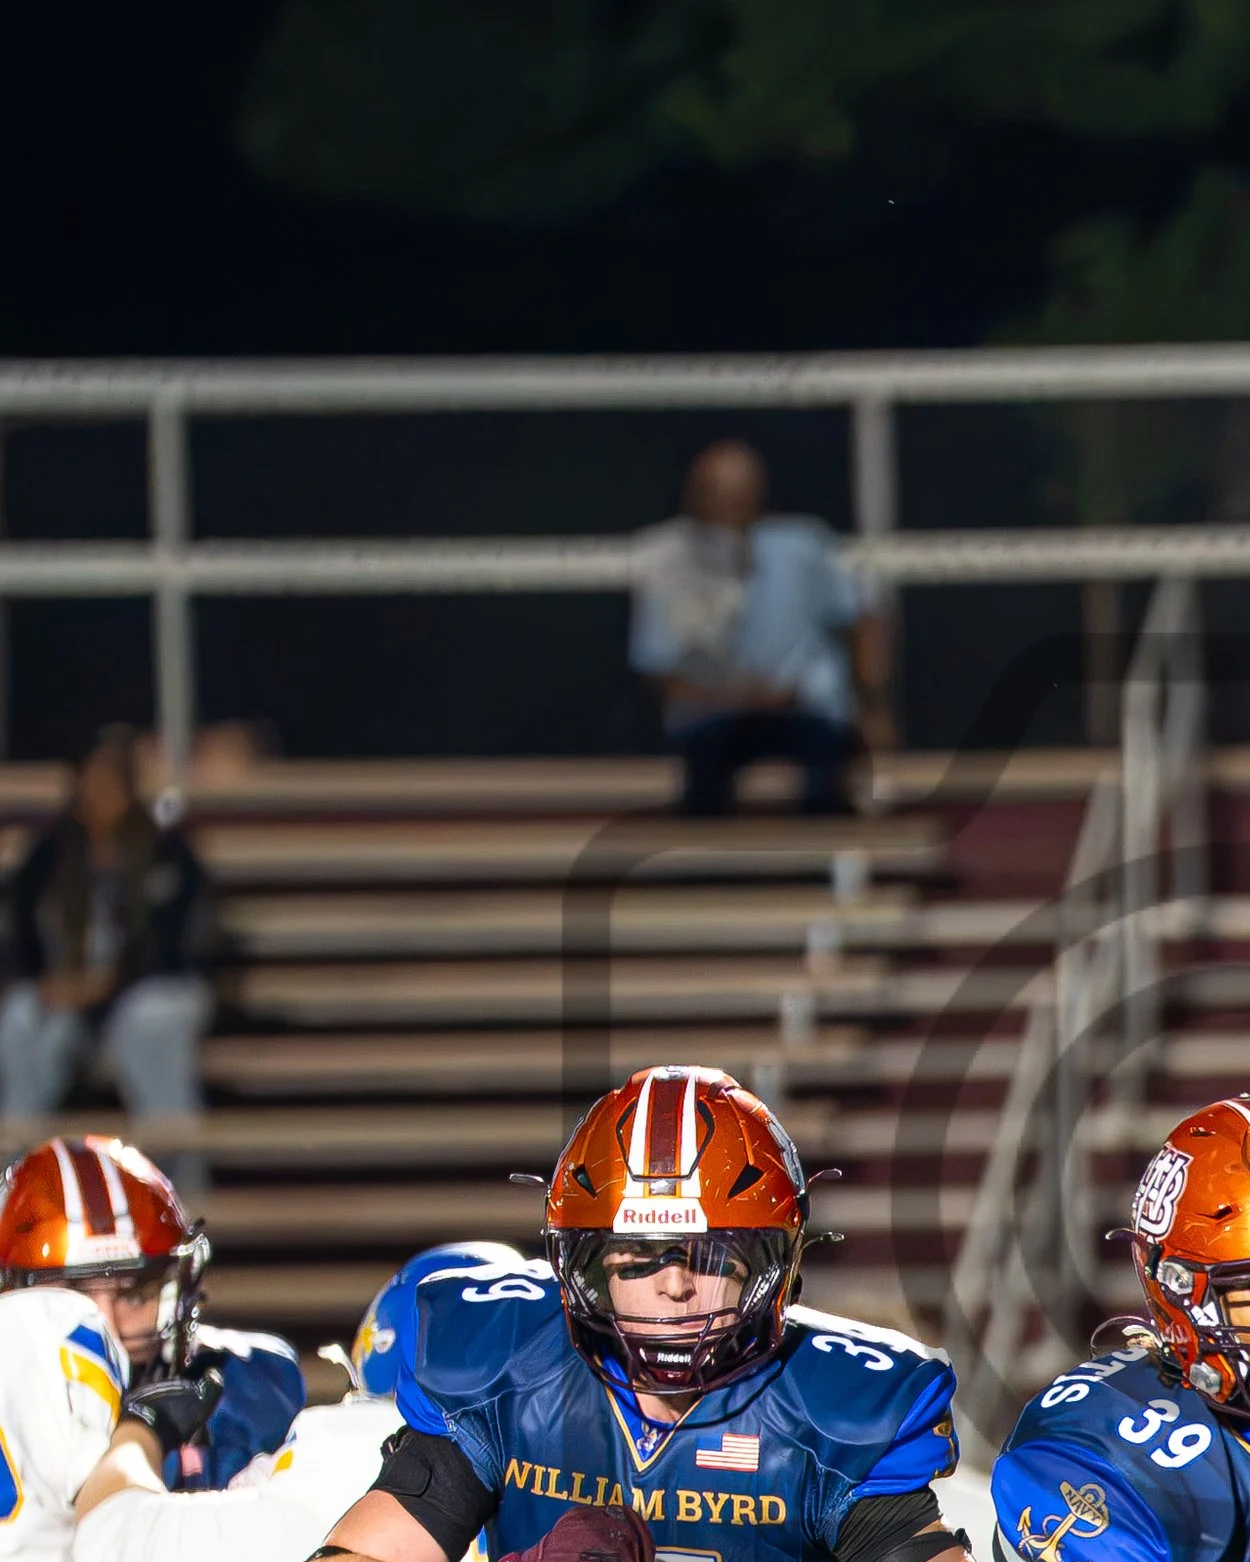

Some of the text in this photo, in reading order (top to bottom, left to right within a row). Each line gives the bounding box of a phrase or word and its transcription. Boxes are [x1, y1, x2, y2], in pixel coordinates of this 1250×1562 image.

[623, 1208, 697, 1224] Riddell
[1118, 1399, 1212, 1469] 39
[676, 1488, 787, 1526] BYRD
